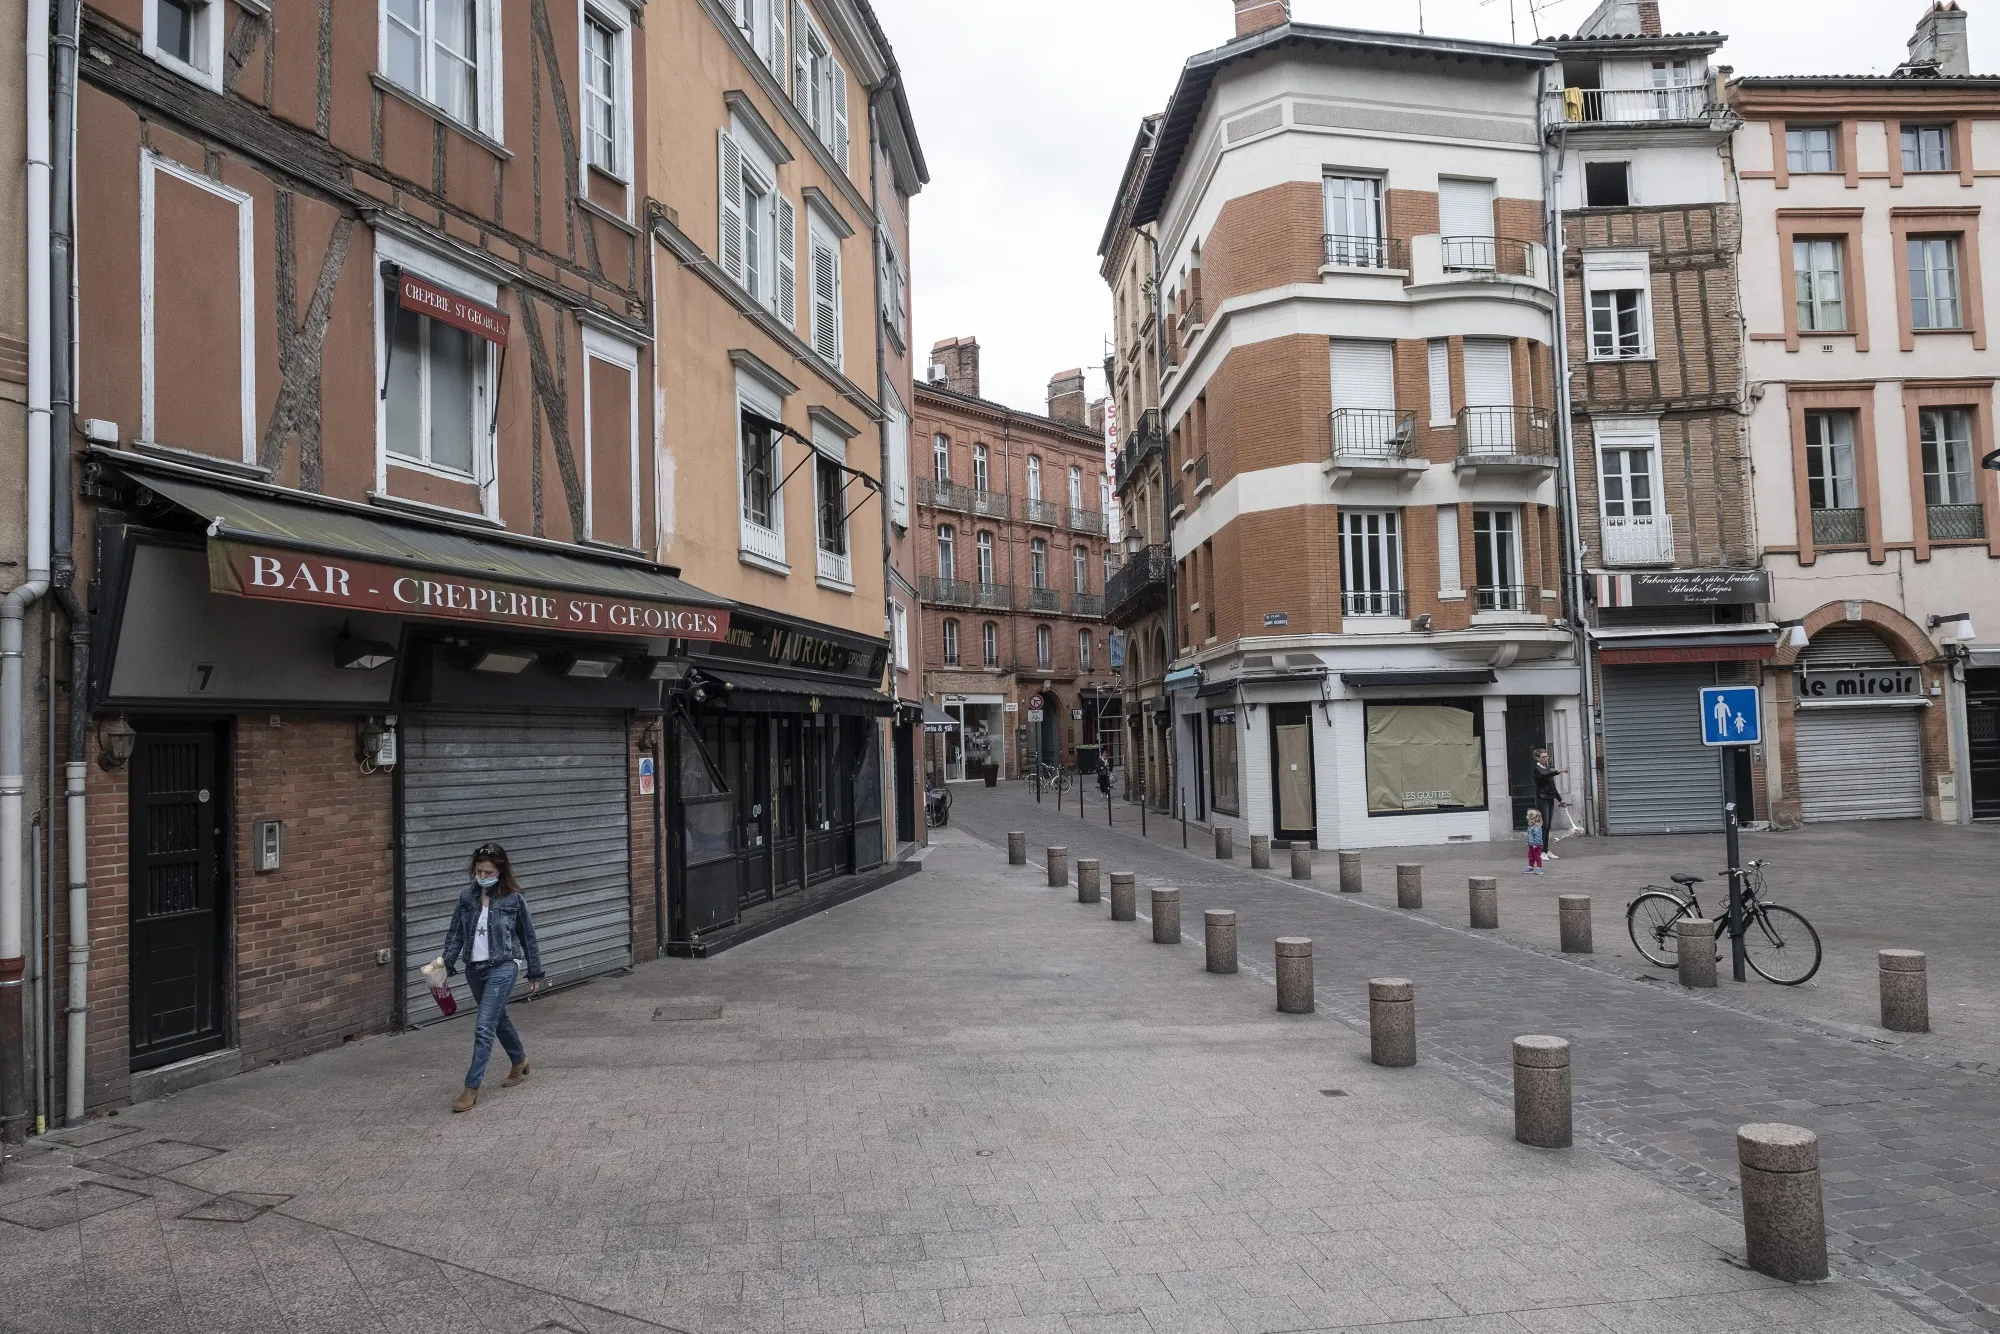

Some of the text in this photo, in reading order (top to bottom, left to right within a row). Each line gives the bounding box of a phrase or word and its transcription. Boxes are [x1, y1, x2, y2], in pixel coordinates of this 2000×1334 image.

[405, 283, 506, 336] CREPERIE ST GEORGES
[1638, 574, 1690, 585] Fabrication
[1691, 575, 1702, 584] de
[249, 555, 350, 596] BAR
[393, 577, 558, 621] CREPERIE
[569, 600, 603, 624] ST
[609, 604, 717, 634] GEORGES
[769, 629, 838, 667] MAURICE
[197, 665, 214, 690] 7
[1836, 671, 1912, 695] miroir
[1417, 790, 1451, 799] GOUTTES
